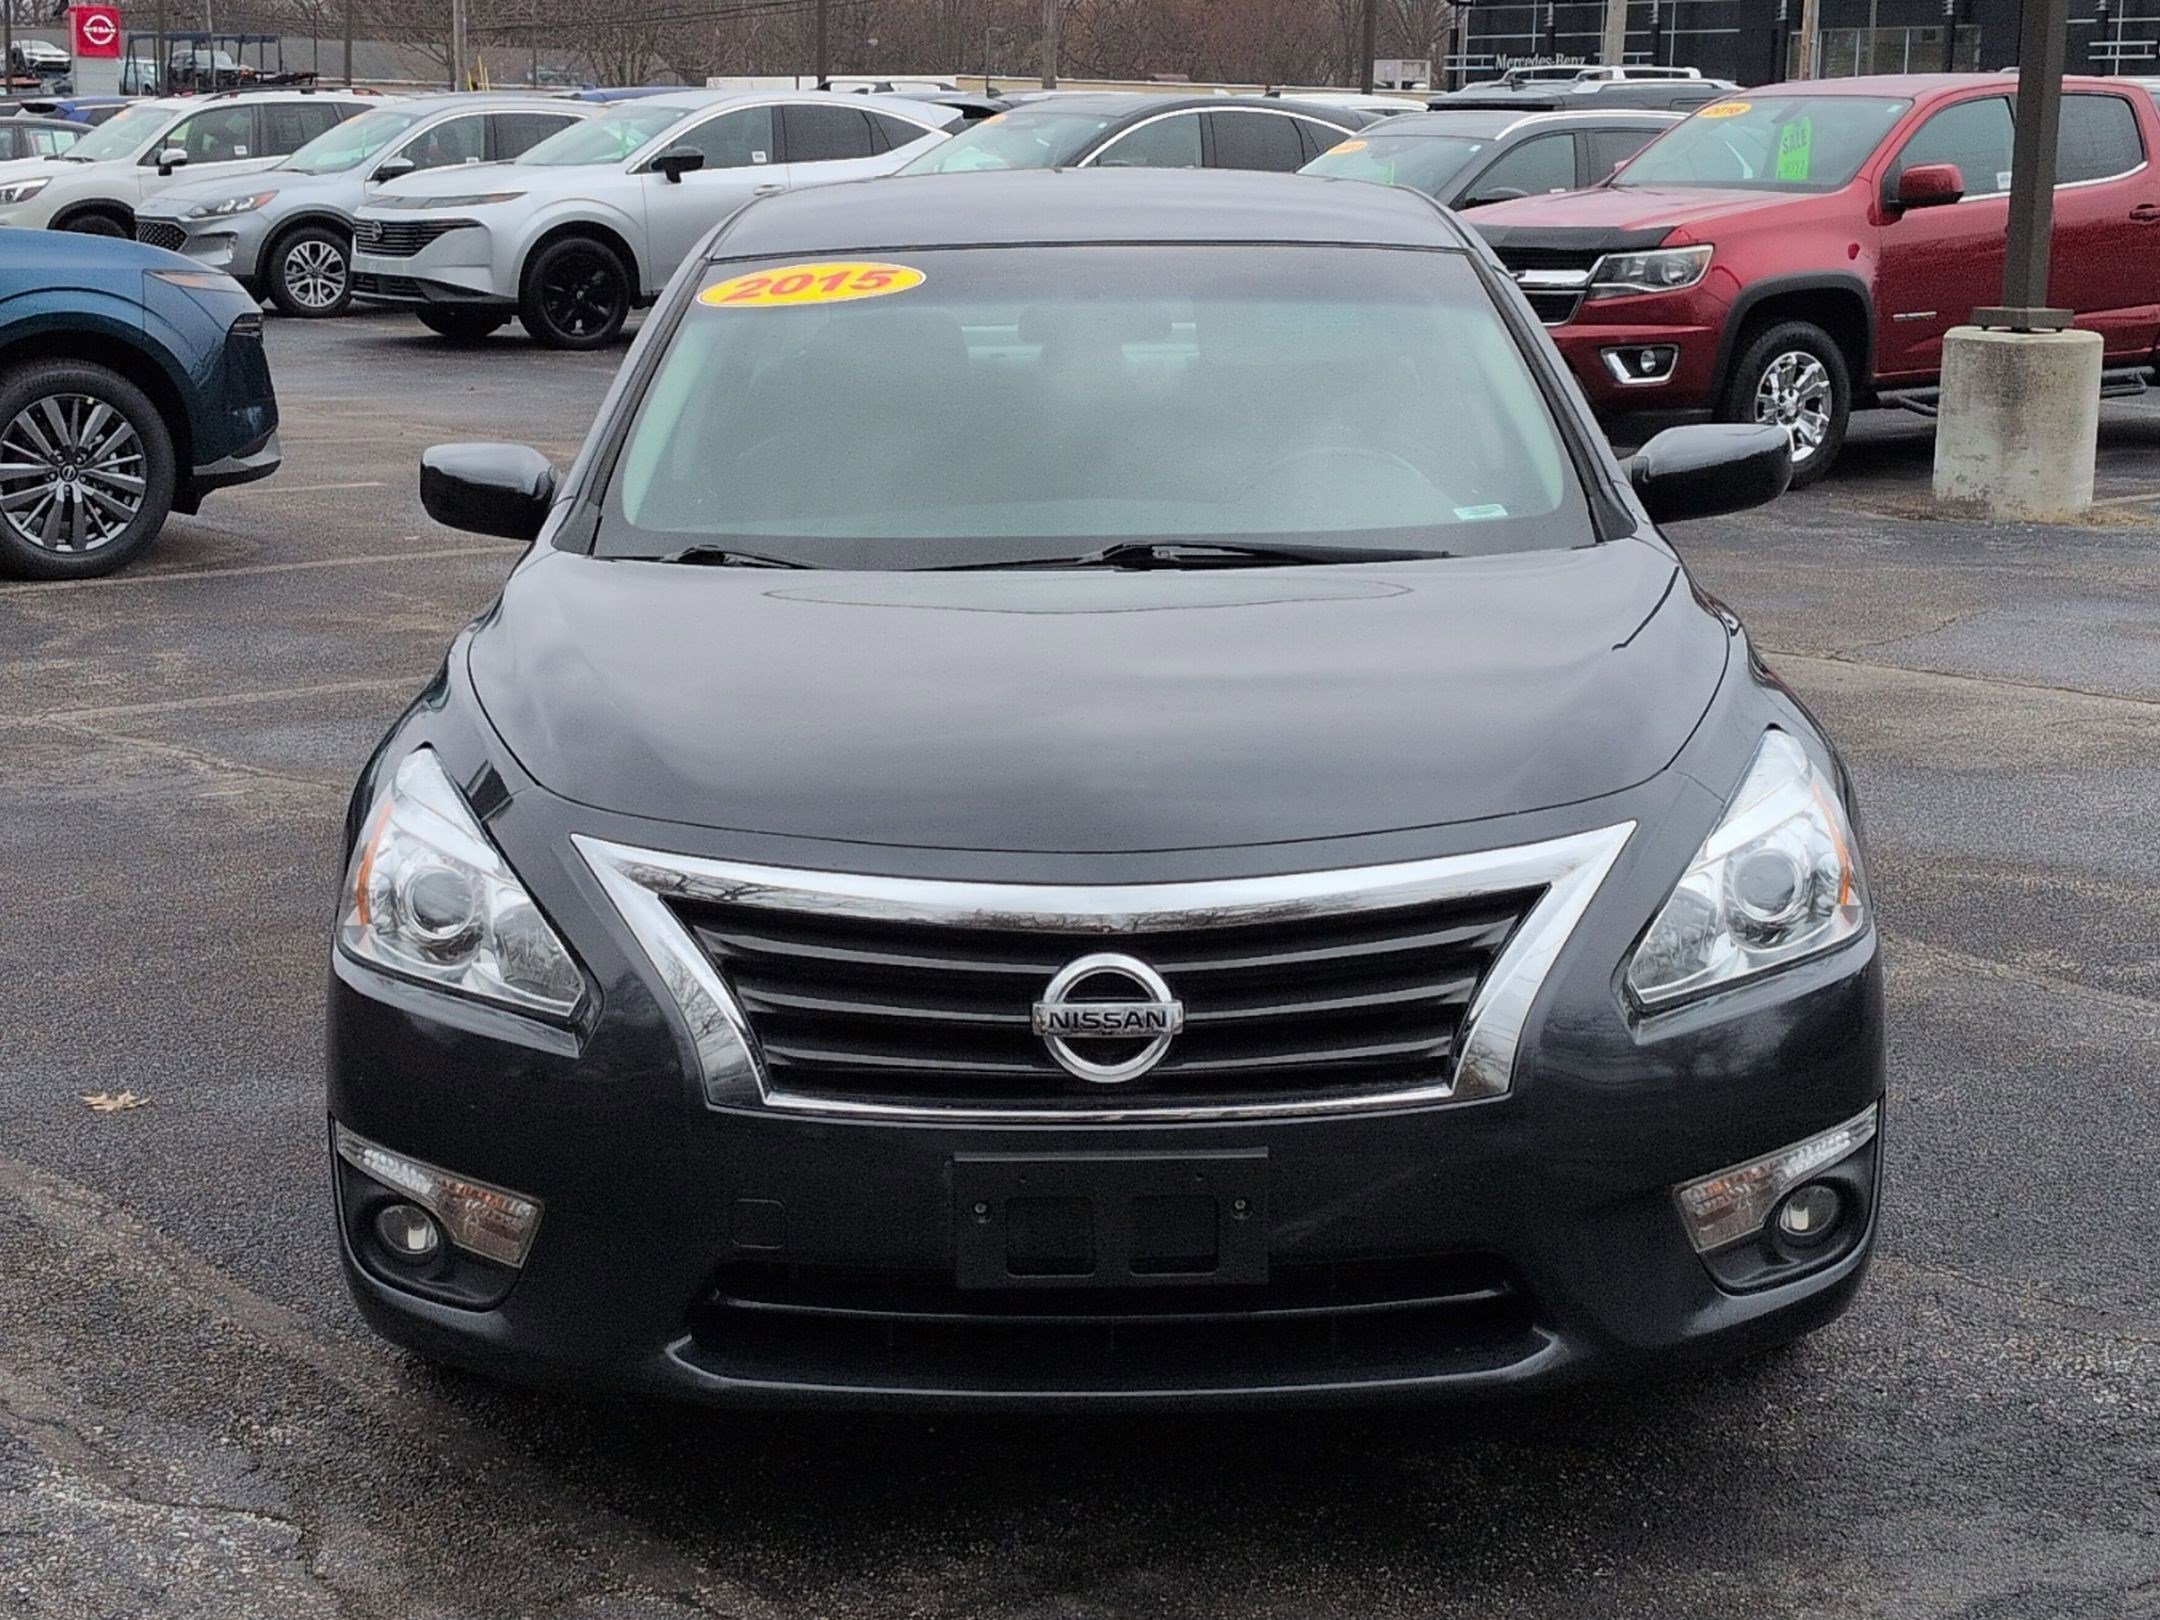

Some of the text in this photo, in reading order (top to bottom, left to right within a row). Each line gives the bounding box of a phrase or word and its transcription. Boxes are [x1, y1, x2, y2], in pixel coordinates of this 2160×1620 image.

[1495, 52, 1586, 70] Mercedes-Benz
[1781, 128, 1808, 155] SALE
[720, 268, 902, 303] 2015
[1048, 1010, 1167, 1030] NISSAN
